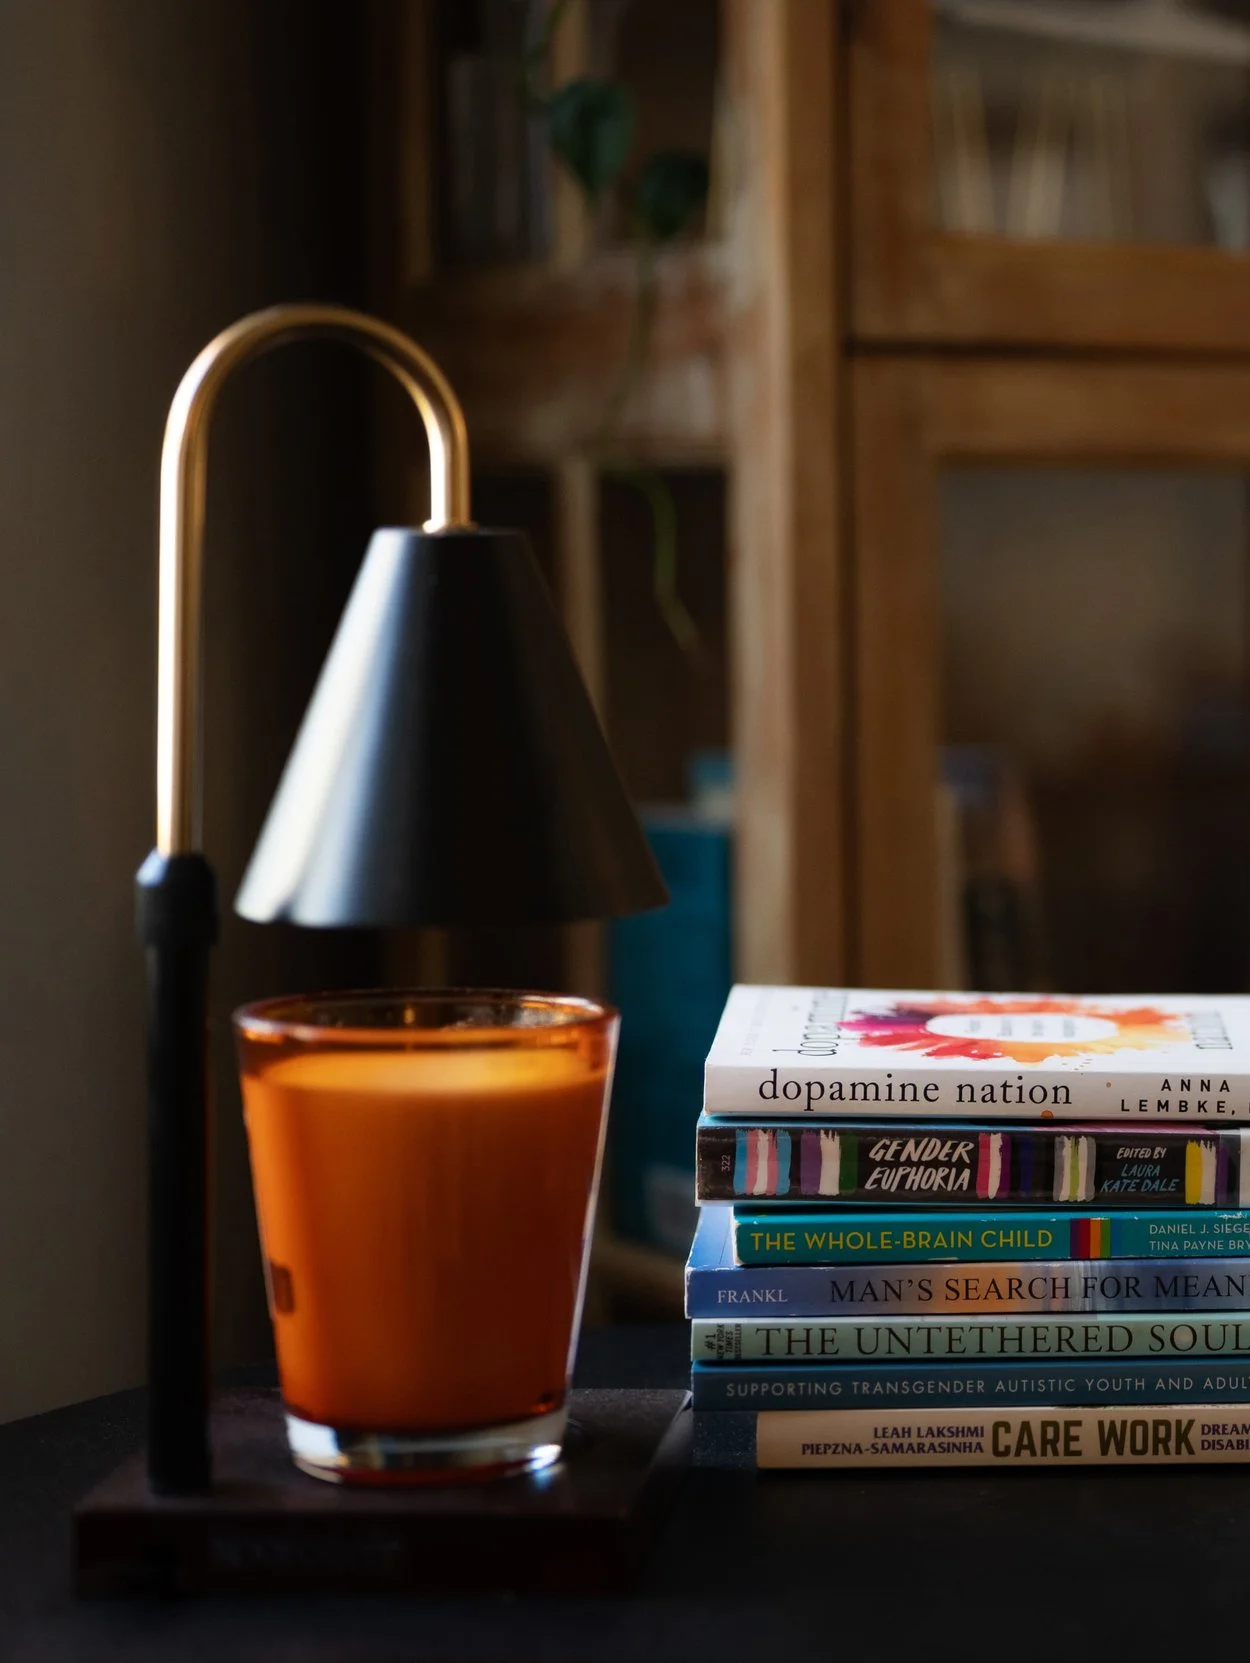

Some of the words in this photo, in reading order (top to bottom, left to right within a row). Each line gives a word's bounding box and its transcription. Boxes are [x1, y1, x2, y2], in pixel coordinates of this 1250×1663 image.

[758, 1069, 940, 1111] dopamine
[956, 1075, 1073, 1105] nation
[1161, 1078, 1231, 1093] ANNA
[1121, 1099, 1236, 1115] LEMBKE,
[868, 1137, 975, 1163] GENDER
[1116, 1147, 1151, 1160] EDITED
[1153, 1146, 1167, 1159] BY
[721, 1154, 731, 1171] 322
[1121, 1163, 1161, 1177] LAURA
[864, 1166, 972, 1193] EUPHORIA
[1100, 1179, 1140, 1193] KATE
[1141, 1178, 1180, 1192] DALE
[1149, 1224, 1196, 1235] DANIEL
[1200, 1223, 1209, 1234] J.
[750, 1232, 796, 1251] THE
[804, 1230, 973, 1250] WHOLE-BRAIN
[980, 1230, 1053, 1248] CHILD
[1149, 1240, 1179, 1250] TINA
[1184, 1240, 1225, 1250] PAYNE
[717, 1289, 788, 1304] FRANKL
[831, 1278, 933, 1303] MAN’S
[944, 1277, 1070, 1301] SEARCH
[1082, 1275, 1144, 1299] FOR
[704, 1334, 716, 1351] #1
[755, 1327, 840, 1356] THE
[856, 1324, 1133, 1355] UNTETHERED
[726, 1381, 843, 1397] SUPPORTING
[852, 1379, 985, 1394] TRANSGENDER
[995, 1378, 1075, 1393] AUTISTIC
[1085, 1377, 1146, 1391] YOUTH
[1155, 1376, 1194, 1390] AND
[873, 1426, 911, 1439] LEAH
[917, 1425, 984, 1439] LAKSHMI
[991, 1420, 1083, 1458] CARE
[1098, 1419, 1196, 1457] WORK
[802, 1440, 984, 1456] PIEPZNA-SAMARASINHA
